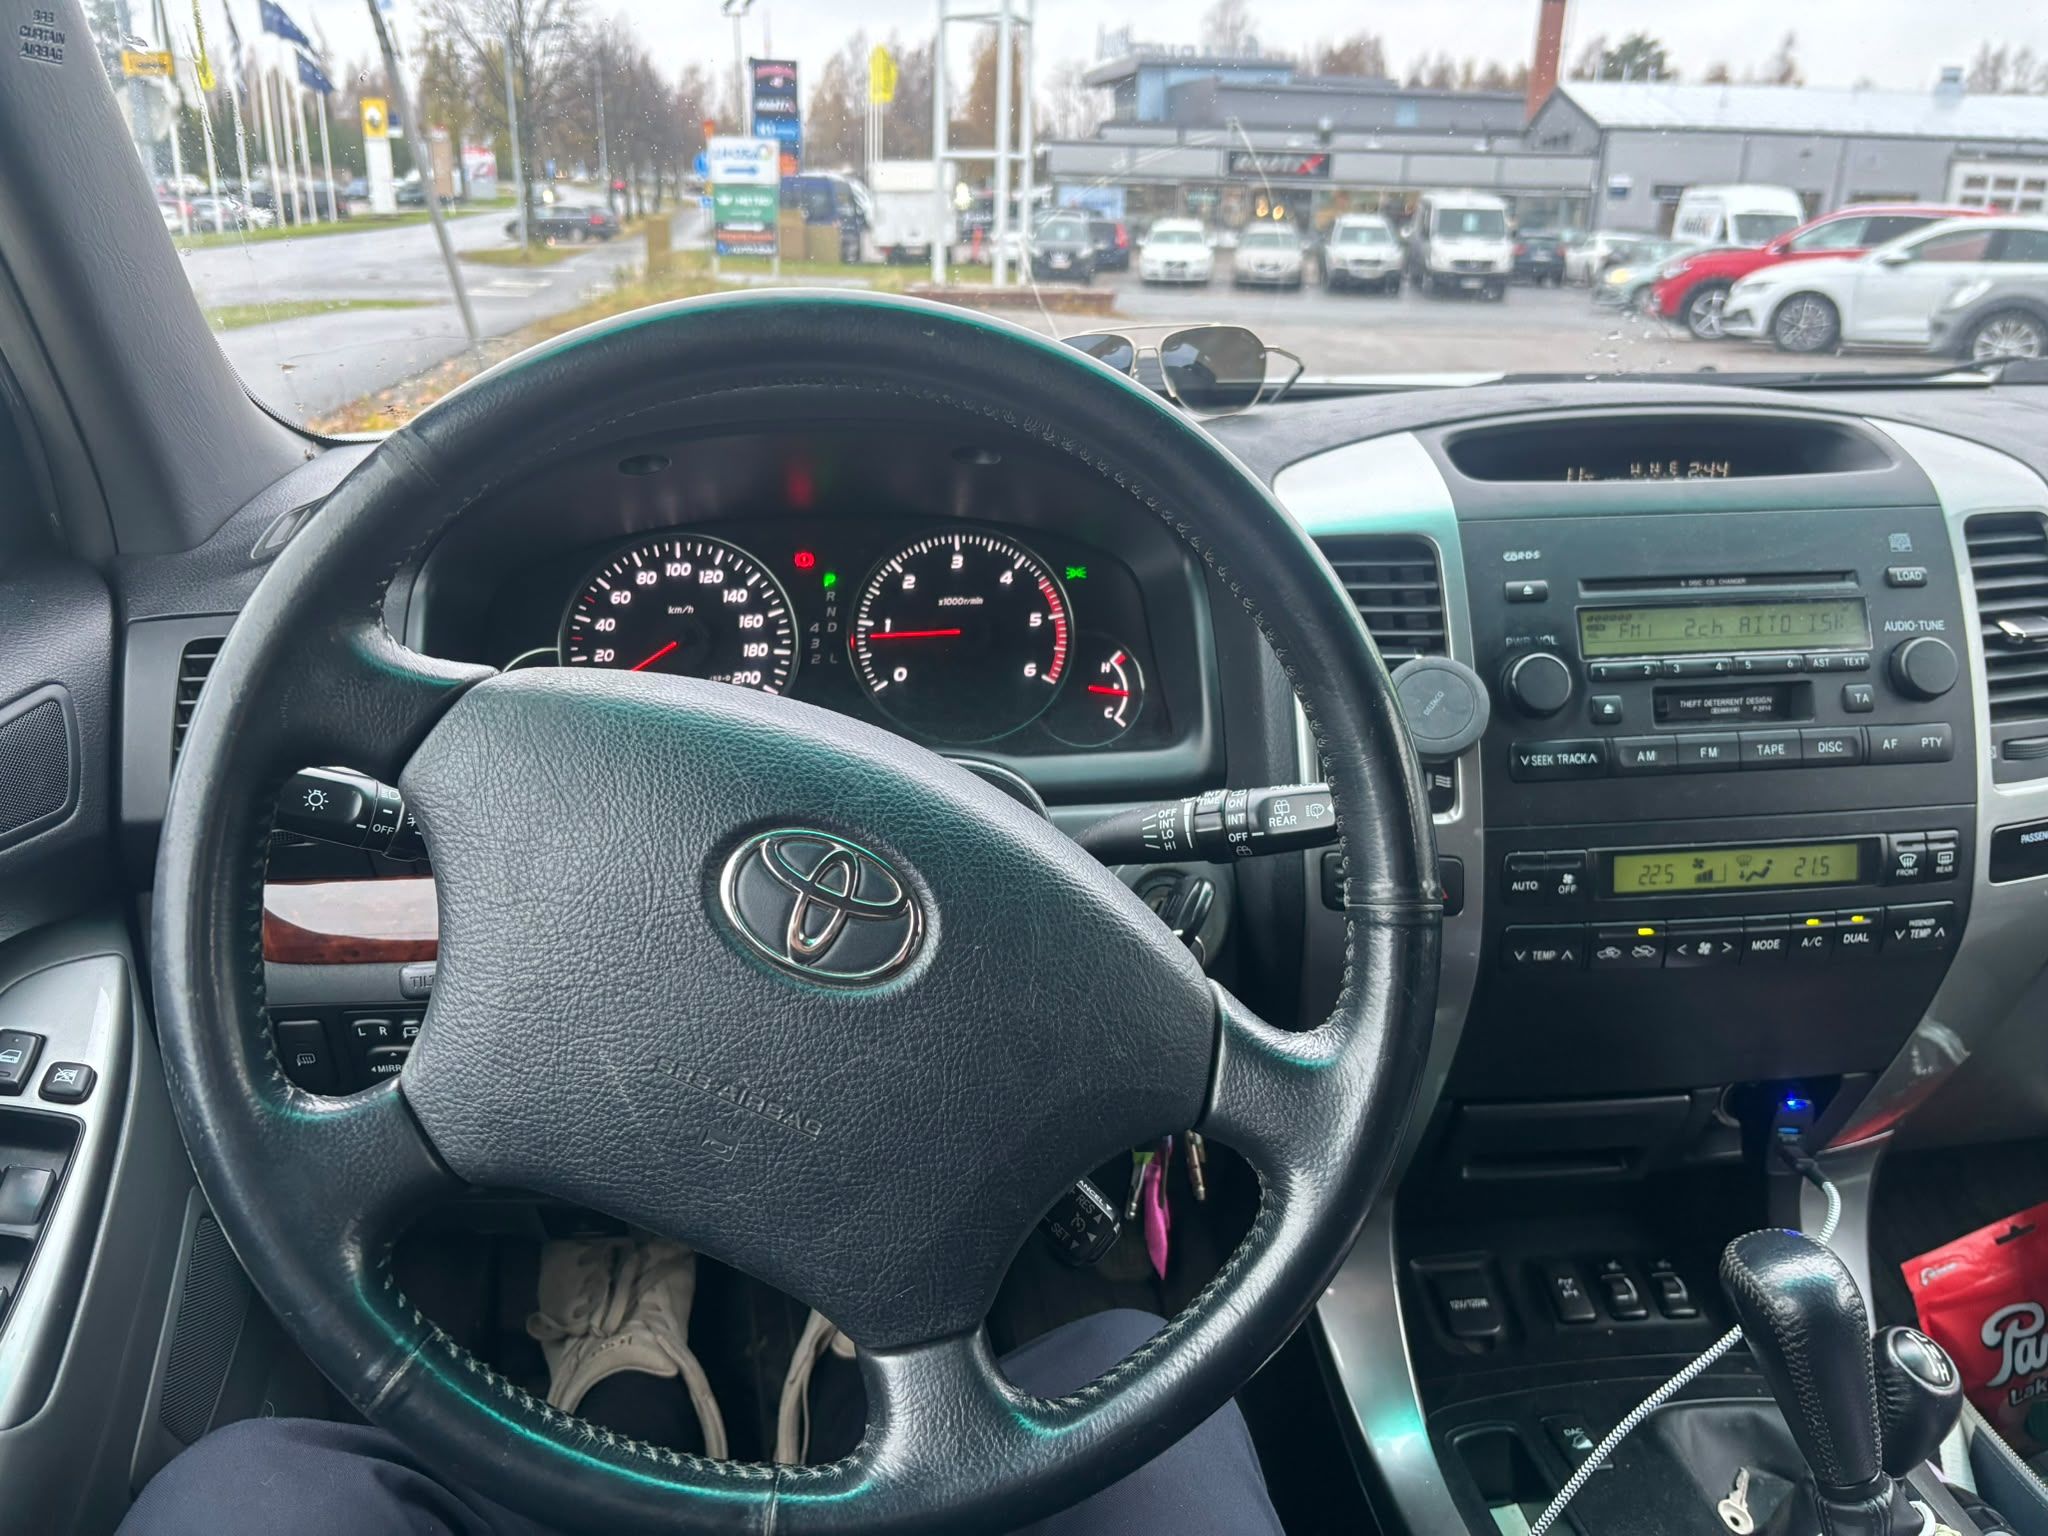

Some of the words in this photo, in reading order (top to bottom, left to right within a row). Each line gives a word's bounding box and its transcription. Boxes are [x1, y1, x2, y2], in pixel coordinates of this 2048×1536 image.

[20, 25, 65, 44] CURTAIN
[20, 42, 63, 60] AIRBAG
[951, 554, 964, 569] 3
[665, 563, 691, 576] 100
[636, 571, 657, 585] 80
[699, 570, 724, 584] 120
[823, 573, 836, 587] P
[902, 575, 916, 589] 2
[999, 571, 1013, 585] 4
[1897, 571, 1922, 581] LOAD
[610, 591, 631, 604] 60
[722, 589, 748, 603] 140
[826, 591, 835, 601] R
[668, 605, 694, 615] km/h
[826, 606, 837, 617] N
[595, 618, 616, 632] 40
[738, 614, 764, 628] 160
[884, 618, 891, 632] 1
[1029, 612, 1042, 627] 5
[809, 622, 819, 633] 4
[827, 622, 837, 632] D
[811, 638, 820, 649] 3
[594, 649, 615, 662] 20
[743, 643, 769, 657] 180
[811, 654, 821, 664] 2
[830, 652, 838, 664] L
[1745, 659, 1752, 669] 5
[1787, 659, 1794, 668] 6
[1813, 658, 1831, 667] AST
[1843, 657, 1866, 667] TEXT
[1023, 663, 1037, 677] 6
[1100, 662, 1111, 673] H
[1600, 667, 1606, 676] 1
[1644, 665, 1651, 675] 2
[1673, 664, 1680, 674] 3
[1715, 661, 1722, 671] 4
[732, 670, 761, 685] 200
[893, 667, 907, 681] 0
[1680, 699, 1702, 709] THEFT
[1703, 697, 1744, 708] DETERRENT
[1746, 696, 1772, 705] DESIGN
[1854, 694, 1870, 704] TA
[1104, 706, 1113, 719] C
[1818, 741, 1843, 753] DISC
[1883, 738, 1898, 749] AF
[1921, 737, 1942, 748] PTY
[1700, 747, 1718, 759] FM
[1757, 743, 1785, 755] TAPE
[1531, 752, 1553, 766] SEEK
[1557, 751, 1588, 765] TRACK
[1637, 750, 1656, 762] AM
[1228, 799, 1243, 809] ON
[1158, 808, 1177, 819] OFF
[1228, 812, 1245, 825] INT
[1159, 818, 1175, 828] INT
[1269, 816, 1297, 828] REAR
[372, 823, 396, 836] OFF
[1162, 829, 1174, 840] LO
[1228, 832, 1248, 843] OFF
[2020, 831, 2048, 845] PASSEN
[1164, 841, 1176, 851] HI
[1896, 867, 1918, 876] FRONT
[1936, 865, 1953, 873] REAR
[1512, 881, 1538, 891] AUTO
[1558, 884, 1577, 895] OFF
[1843, 933, 1869, 944] DUAL
[1910, 928, 1932, 939] TEMP
[1752, 939, 1780, 951] MODE
[1801, 936, 1822, 948] A/C
[1533, 950, 1555, 961] TEMP
[357, 1028, 366, 1036] L
[379, 1026, 388, 1036] R
[377, 1064, 401, 1073] MIRR
[718, 1085, 823, 1136] AIRBAG
[1079, 1180, 1104, 1206] ANCEL
[1076, 1194, 1096, 1214] RES
[1051, 1222, 1071, 1241] SET
[1981, 1301, 2048, 1388] Pa
[1925, 1343, 1942, 1360] N
[1937, 1362, 1950, 1381] H
[2010, 1377, 2048, 1407] Lak
[1563, 1427, 1584, 1437] DAC
